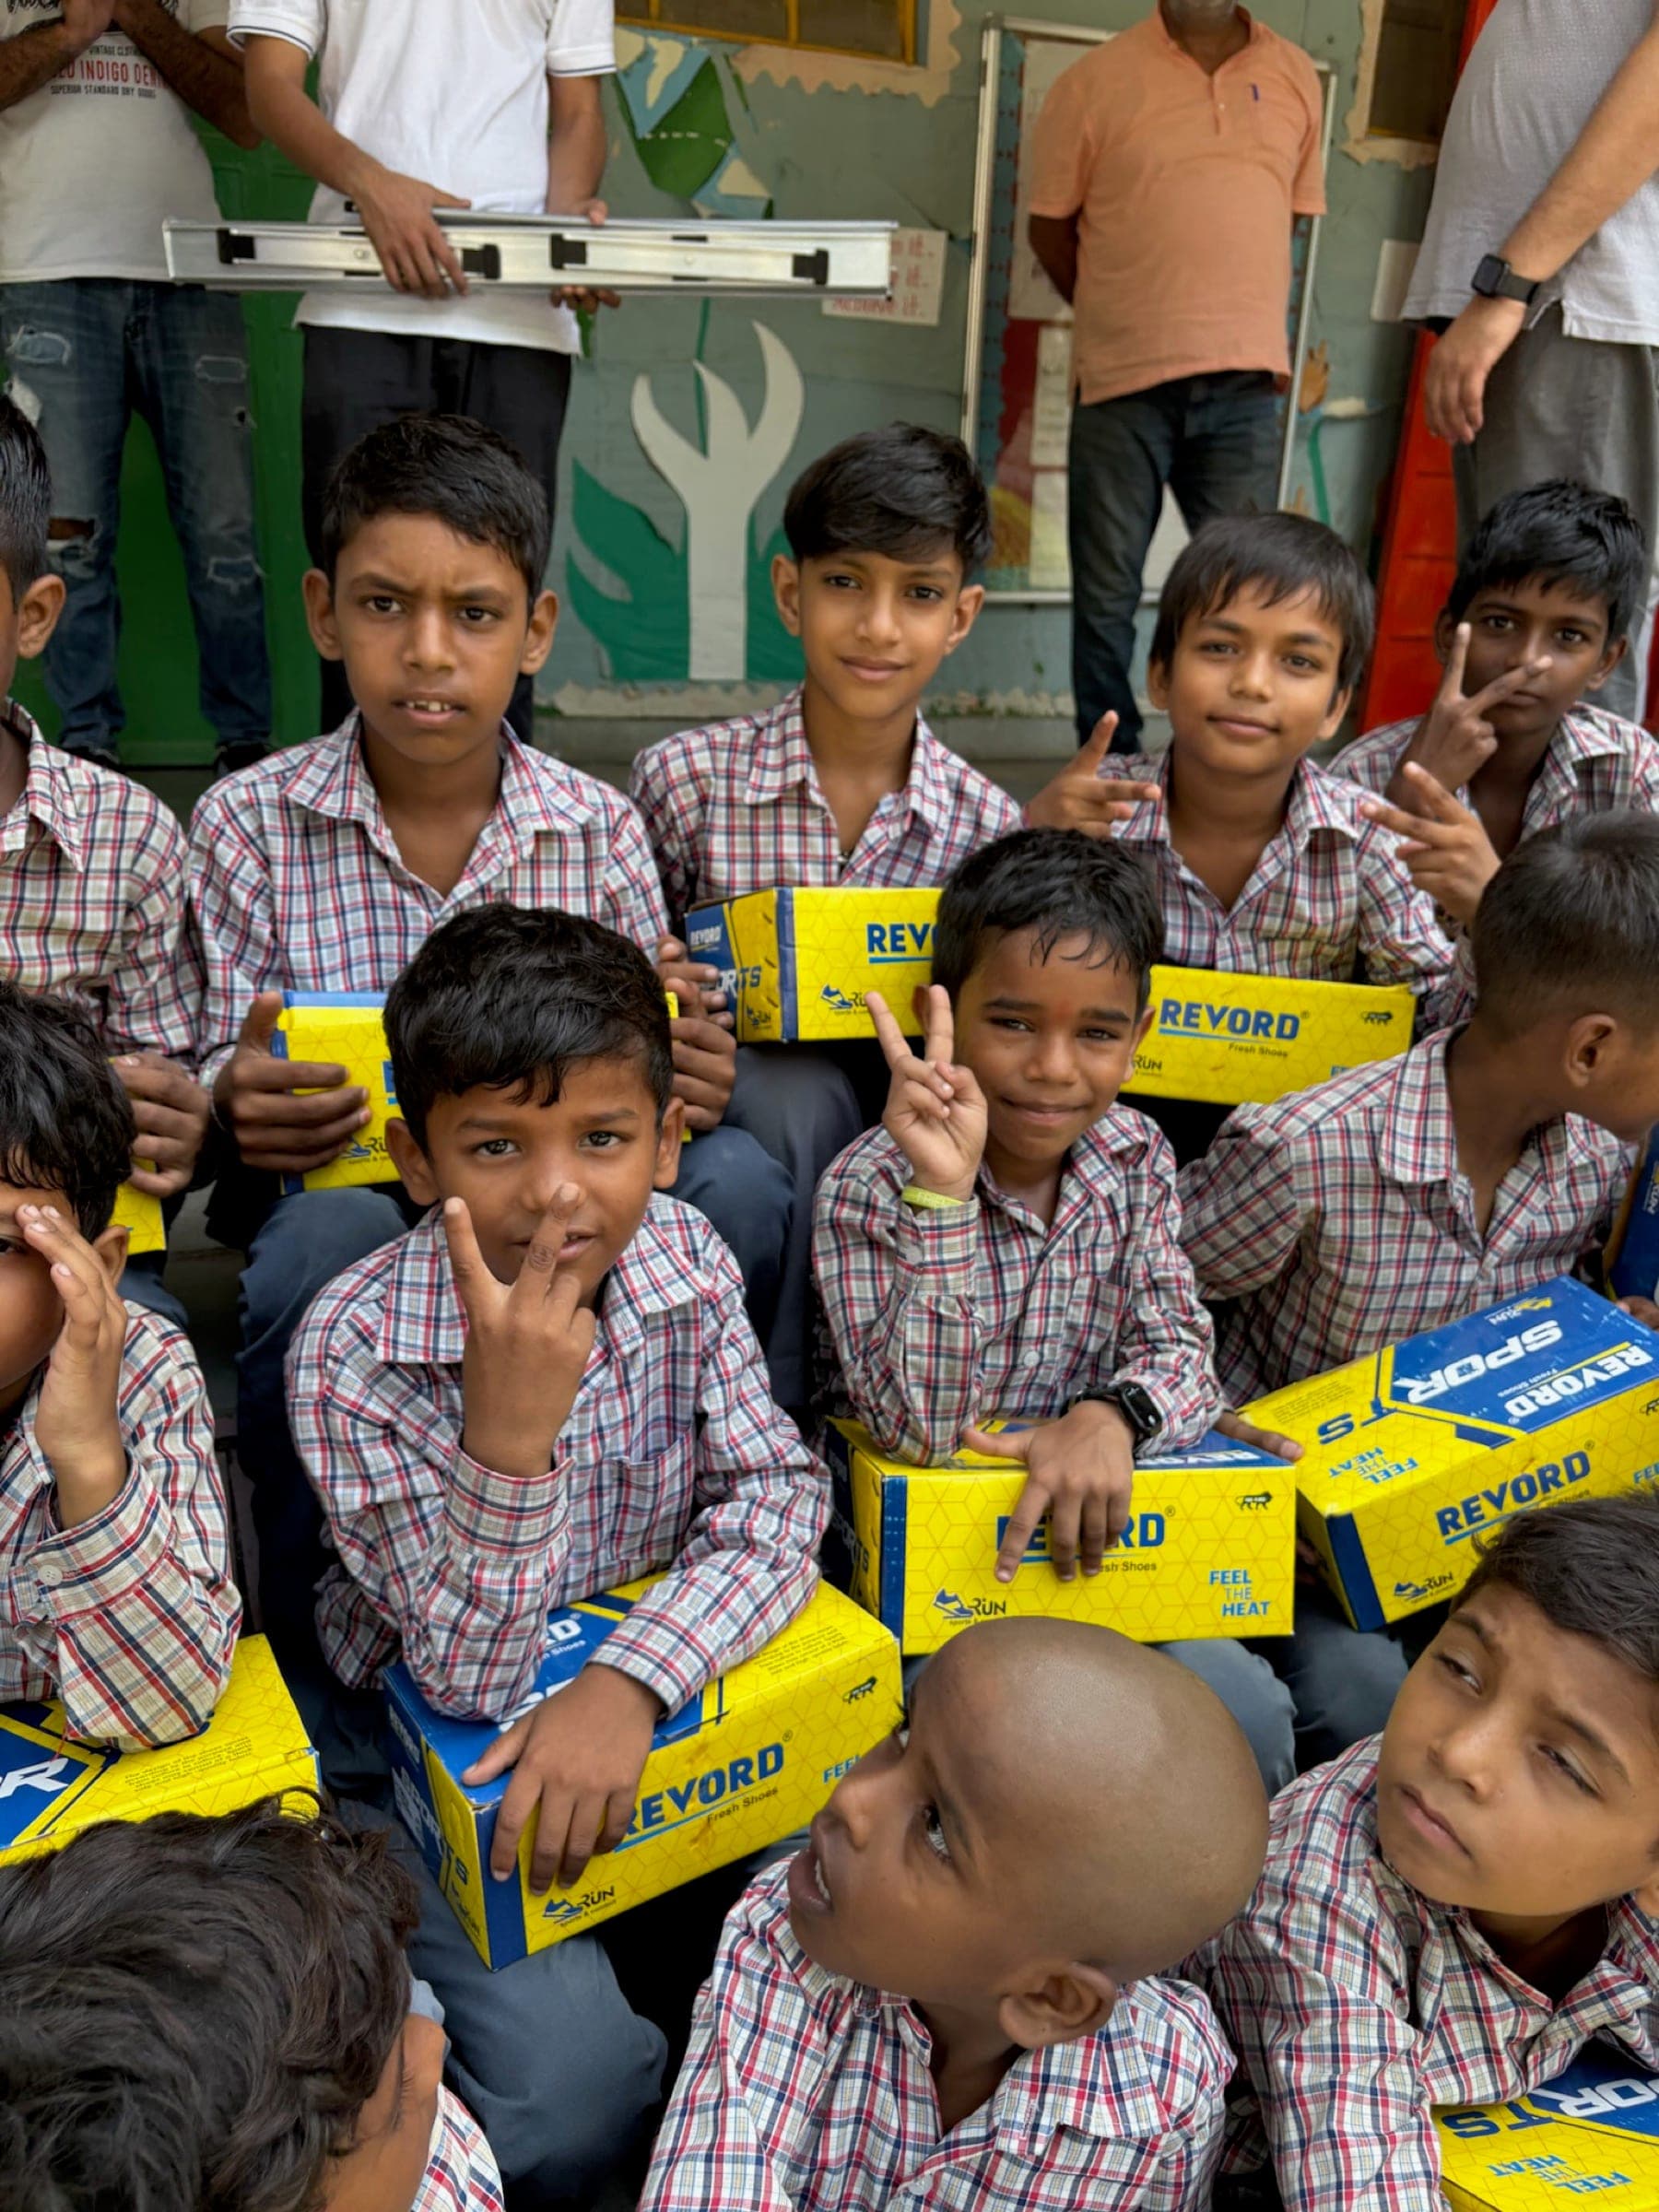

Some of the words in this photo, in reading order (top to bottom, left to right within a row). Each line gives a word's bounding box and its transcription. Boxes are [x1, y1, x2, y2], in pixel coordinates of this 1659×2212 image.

[80, 59, 129, 82] INDIGO
[85, 85, 120, 96] STANDARD
[866, 923, 940, 953] REV
[1159, 998, 1300, 1041] REVORD
[1228, 1042, 1256, 1055] Fresh
[1258, 1043, 1288, 1058] Shoes
[1503, 1345, 1654, 1418] REVORD
[1328, 1446, 1384, 1478] HEAT
[1356, 1456, 1389, 1476] THE
[1363, 1457, 1419, 1484] FEEL
[1434, 1450, 1591, 1537] REVORD
[1121, 1560, 1157, 1572] Shoes
[1209, 1570, 1252, 1585] FEEL
[1225, 1587, 1252, 1601] THE
[1221, 1601, 1271, 1618] HEAT
[551, 1640, 586, 1656] Shoes
[627, 1742, 783, 1835] EVORD
[707, 1802, 740, 1825] Fresh
[741, 1786, 779, 1808] Shoes
[1488, 2153, 1568, 2177] HEAT
[1533, 2166, 1584, 2183] THE
[1554, 2170, 1634, 2194] FEEL
